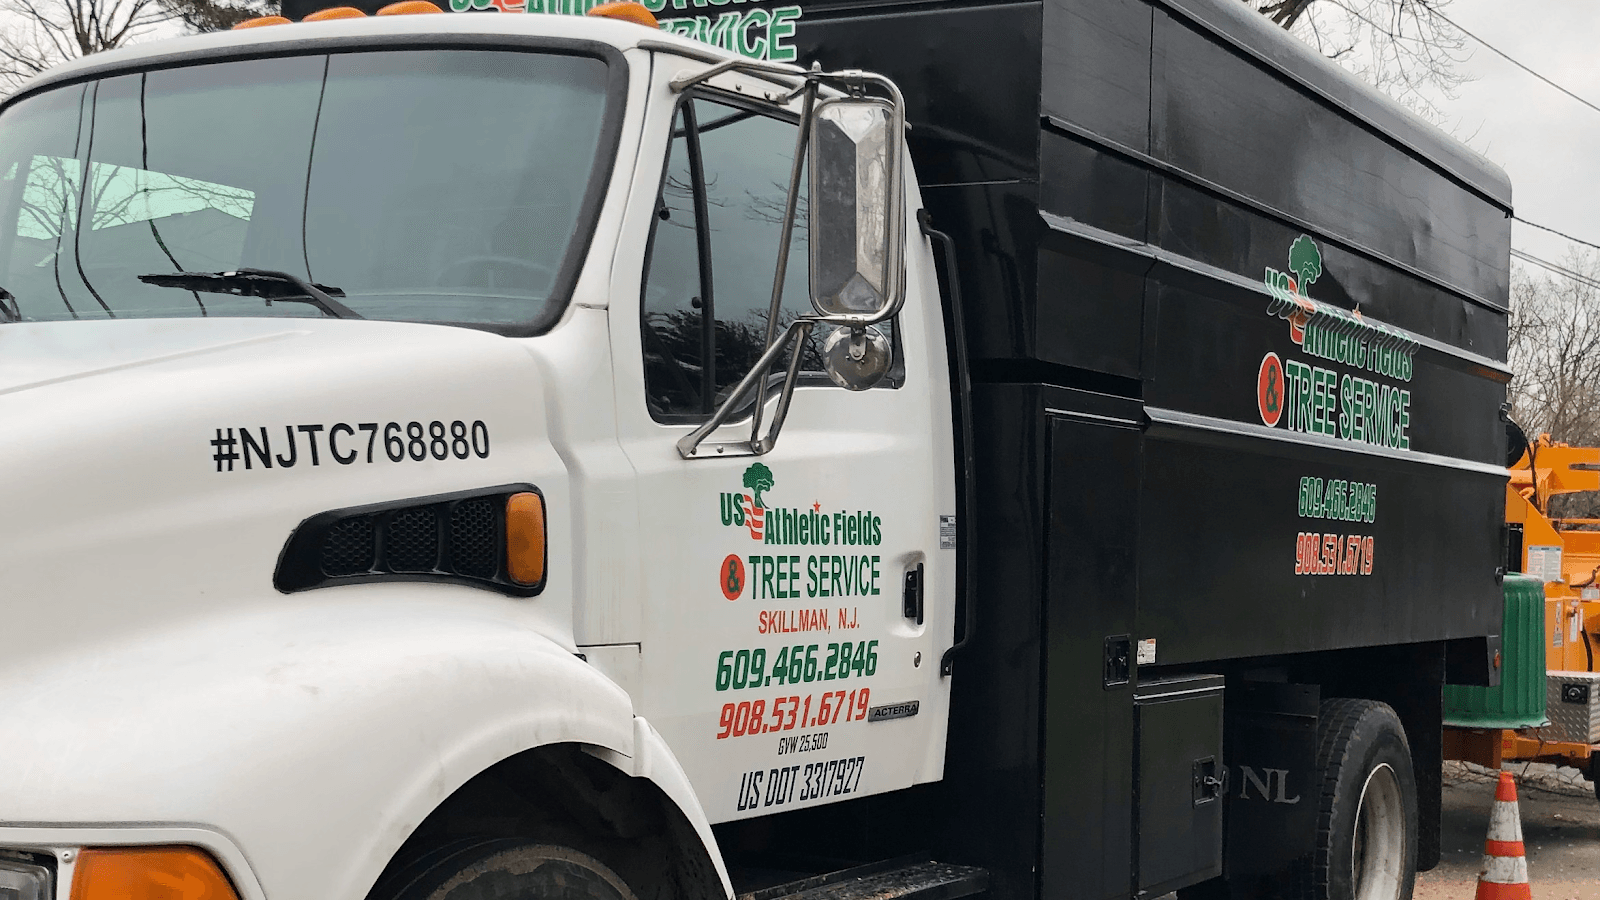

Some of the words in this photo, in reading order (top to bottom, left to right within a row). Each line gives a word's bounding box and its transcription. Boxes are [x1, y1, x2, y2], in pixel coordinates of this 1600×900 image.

[658, 6, 802, 63] VICE
[1286, 359, 1338, 439] TREE
[1339, 373, 1411, 451] SERVICE
[210, 420, 491, 472] #NJTC768880
[719, 492, 746, 526] US
[1298, 476, 1377, 524] 609.466.2846
[764, 506, 831, 545] Athletic
[833, 509, 882, 545] Fields
[748, 555, 801, 600] TREE
[806, 554, 881, 599] SERVICE
[1294, 531, 1375, 576] 908.531.6719
[758, 608, 831, 635] SKILLMAN,
[838, 606, 860, 630] N.J.
[715, 639, 879, 692] 609.466.2846
[716, 687, 870, 740] 908.531.6719
[874, 704, 917, 717] ACTERRA
[777, 735, 799, 756] GVW
[798, 732, 829, 753] 25,500
[736, 770, 764, 811] US
[764, 764, 801, 808] DOT
[800, 756, 866, 801] 3317927
